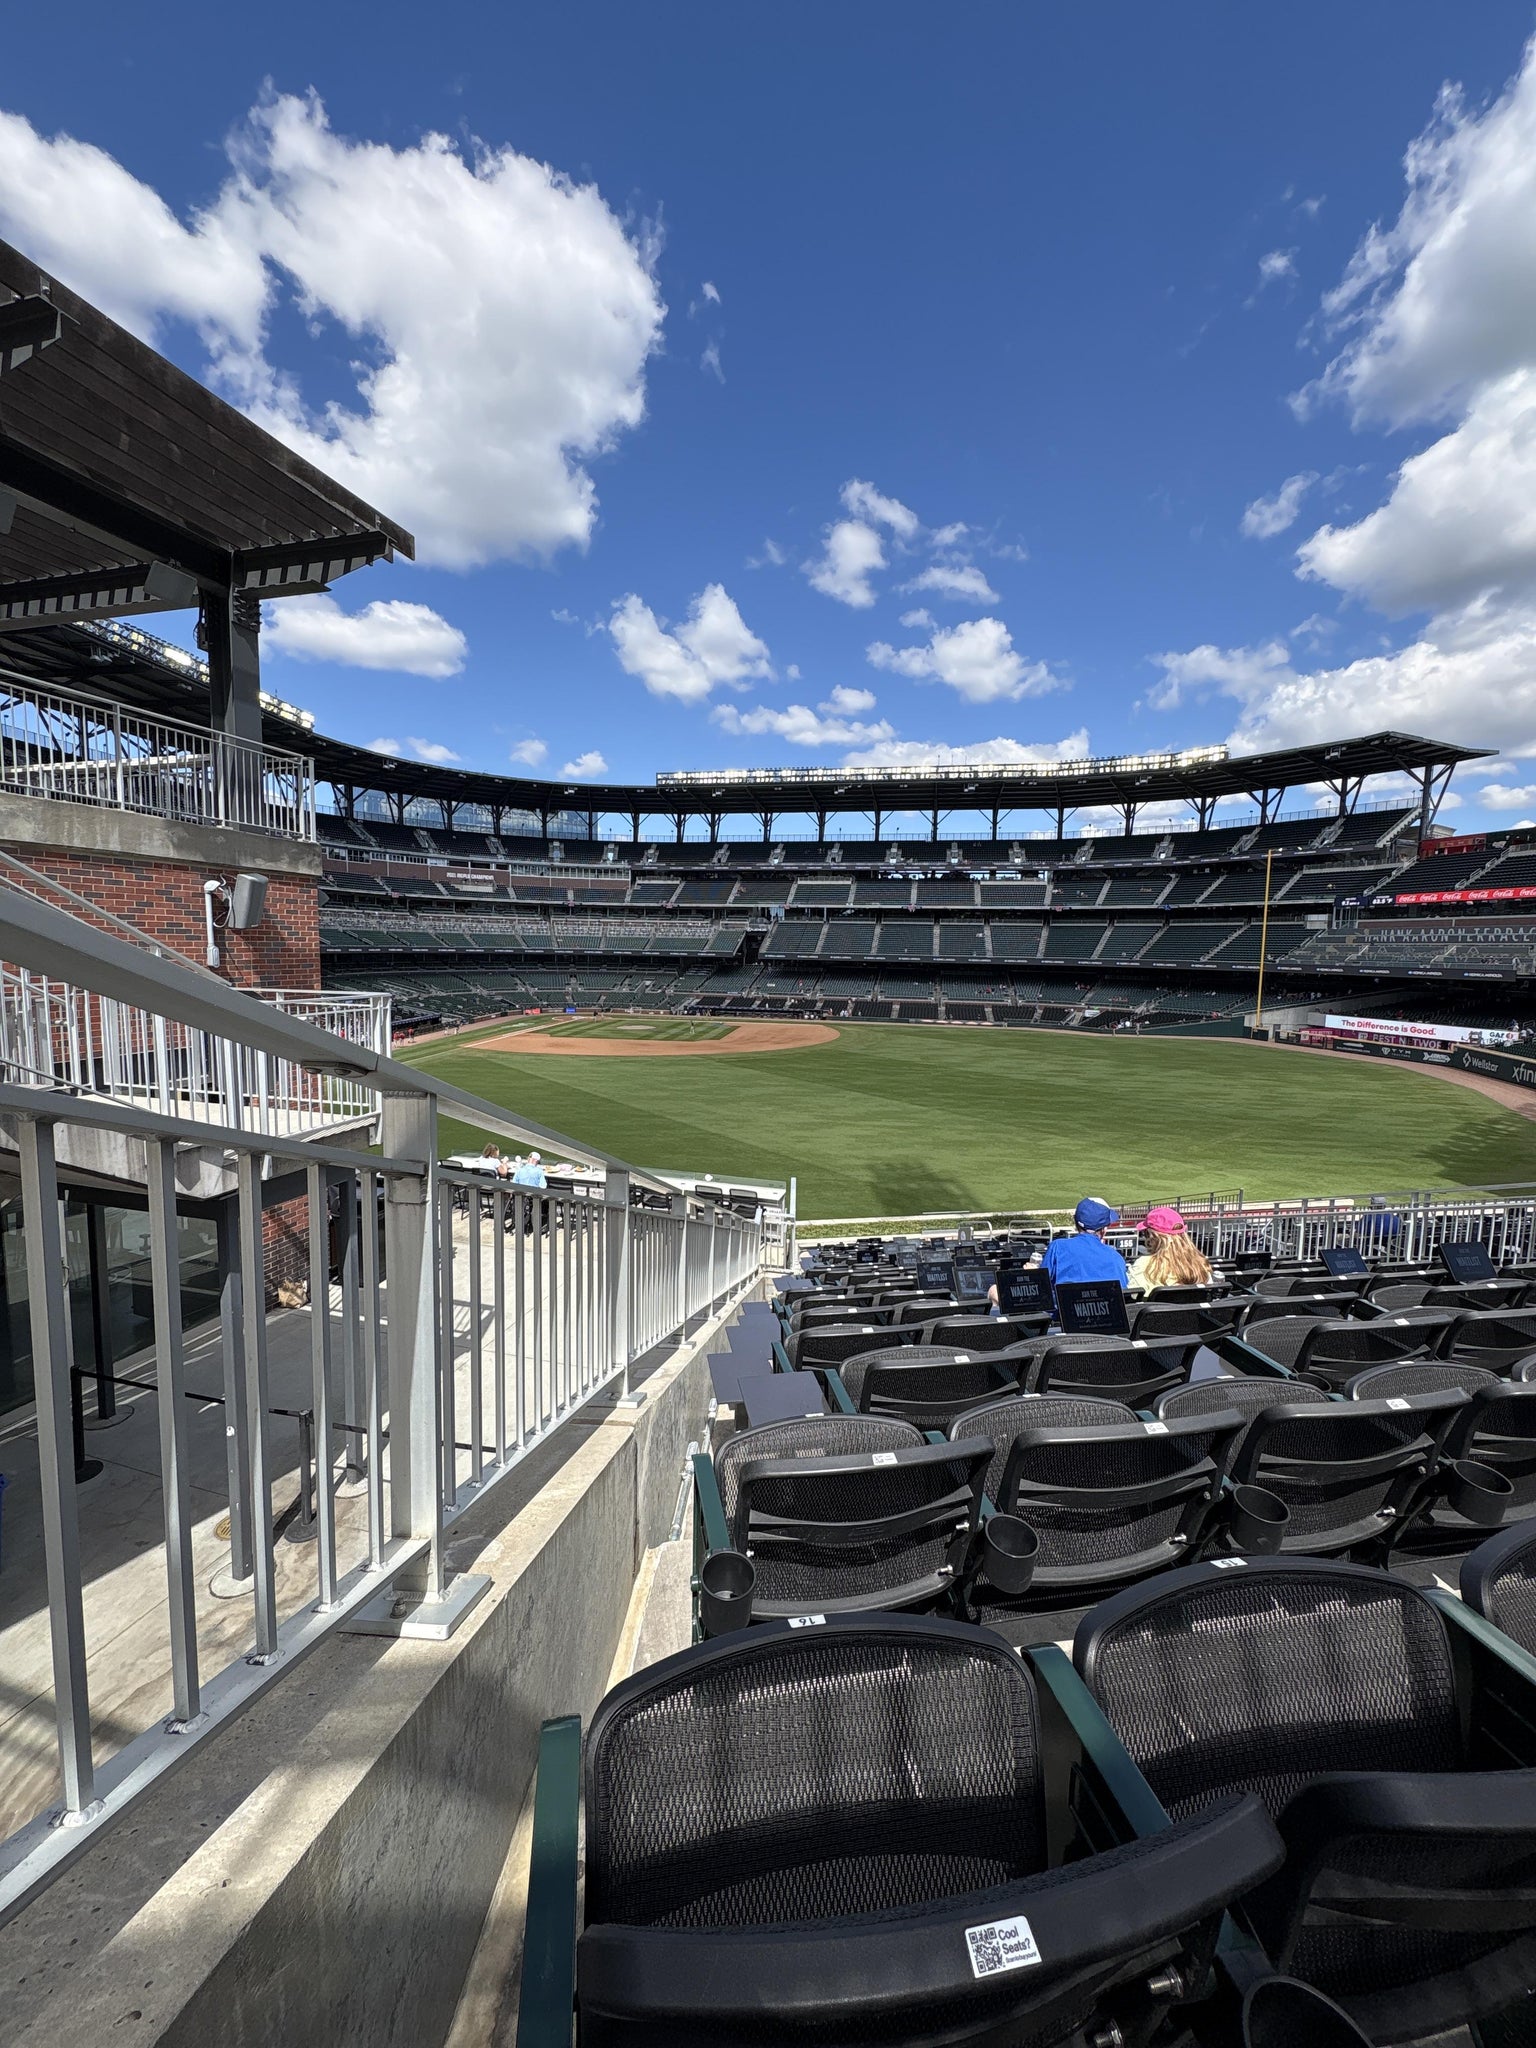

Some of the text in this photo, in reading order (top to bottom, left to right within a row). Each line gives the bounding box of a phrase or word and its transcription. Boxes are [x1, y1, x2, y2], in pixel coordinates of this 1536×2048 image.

[1442, 892, 1462, 900] Coca-Cola
[1468, 891, 1489, 899] Coca-Cola
[1493, 889, 1514, 897] Coca-Cola
[1341, 1019, 1356, 1027] The
[1356, 1020, 1399, 1031] Difference
[1401, 1024, 1408, 1032] is
[1472, 1057, 1499, 1072] Wellstar
[1119, 1239, 1133, 1248] 155
[1010, 1284, 1039, 1298] WAITLIST
[1074, 1301, 1110, 1317] WAITLIST
[1220, 1559, 1238, 1567] 15
[798, 1617, 816, 1626] 16
[998, 1925, 1019, 1941] Cool
[1002, 1937, 1031, 1955] Seats?
